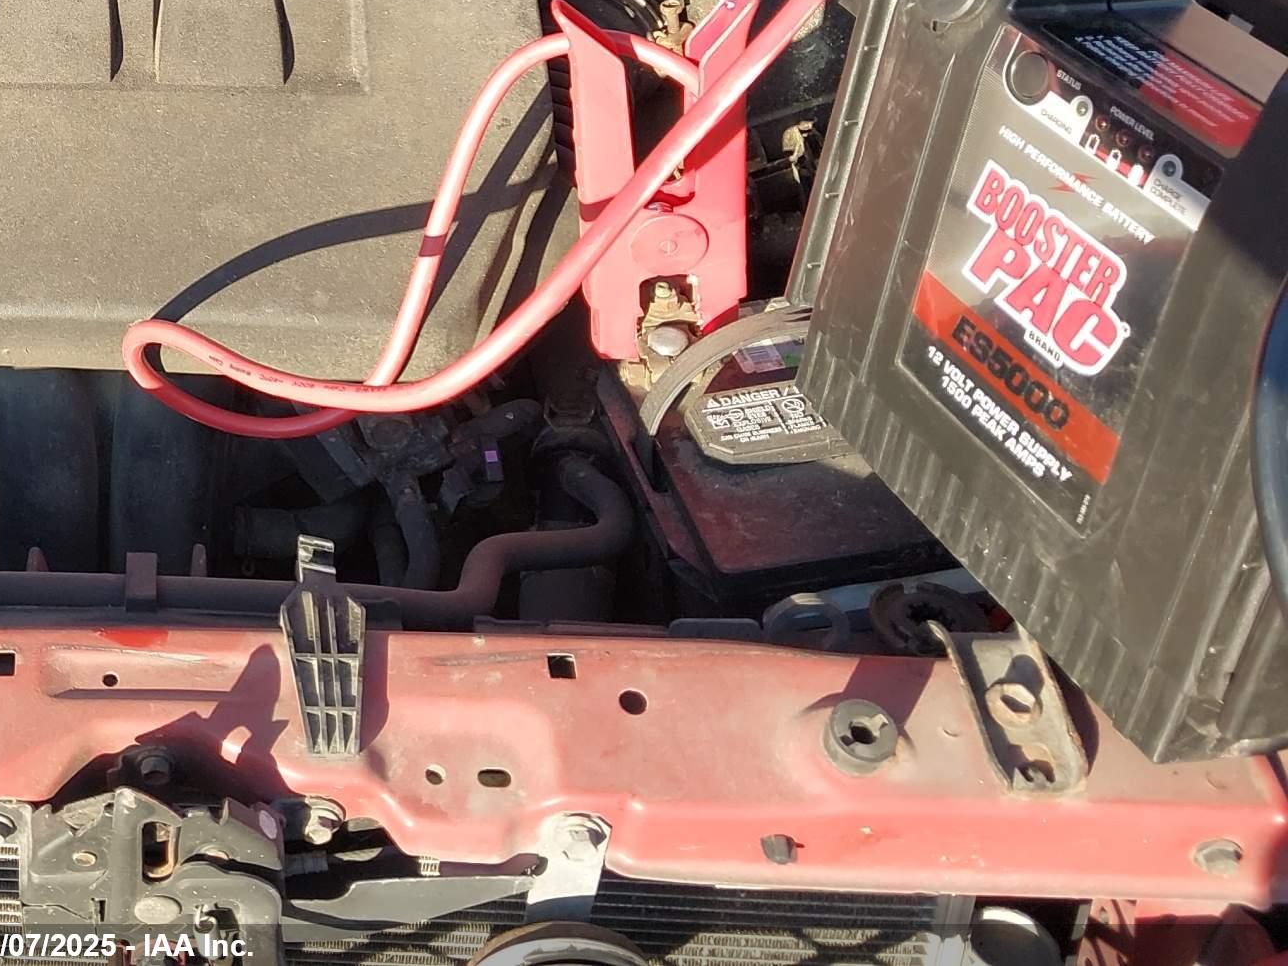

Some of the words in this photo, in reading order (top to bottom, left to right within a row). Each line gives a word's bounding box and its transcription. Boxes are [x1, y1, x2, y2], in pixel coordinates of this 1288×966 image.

[1040, 107, 1073, 135] CHARGING
[1056, 69, 1082, 91] STATUS
[1110, 106, 1134, 129] POWER
[1133, 121, 1155, 141] LEVEL
[998, 125, 1024, 150] HIGH
[1023, 144, 1105, 208] PERFORMANCE
[1101, 201, 1157, 246] BATTERY
[973, 168, 1120, 308] BOOSTER
[969, 228, 1118, 367] PAC
[1028, 330, 1062, 363] BRAND
[719, 389, 781, 407] DANGER
[927, 345, 944, 366] 12
[943, 359, 975, 392] VOLT
[973, 388, 1020, 437] POWER
[1018, 430, 1073, 483] SUPPLY
[951, 315, 1071, 430] ES5000
[941, 375, 973, 410] 1500
[971, 404, 1008, 442] PEAK
[1005, 437, 1046, 479] AMPS
